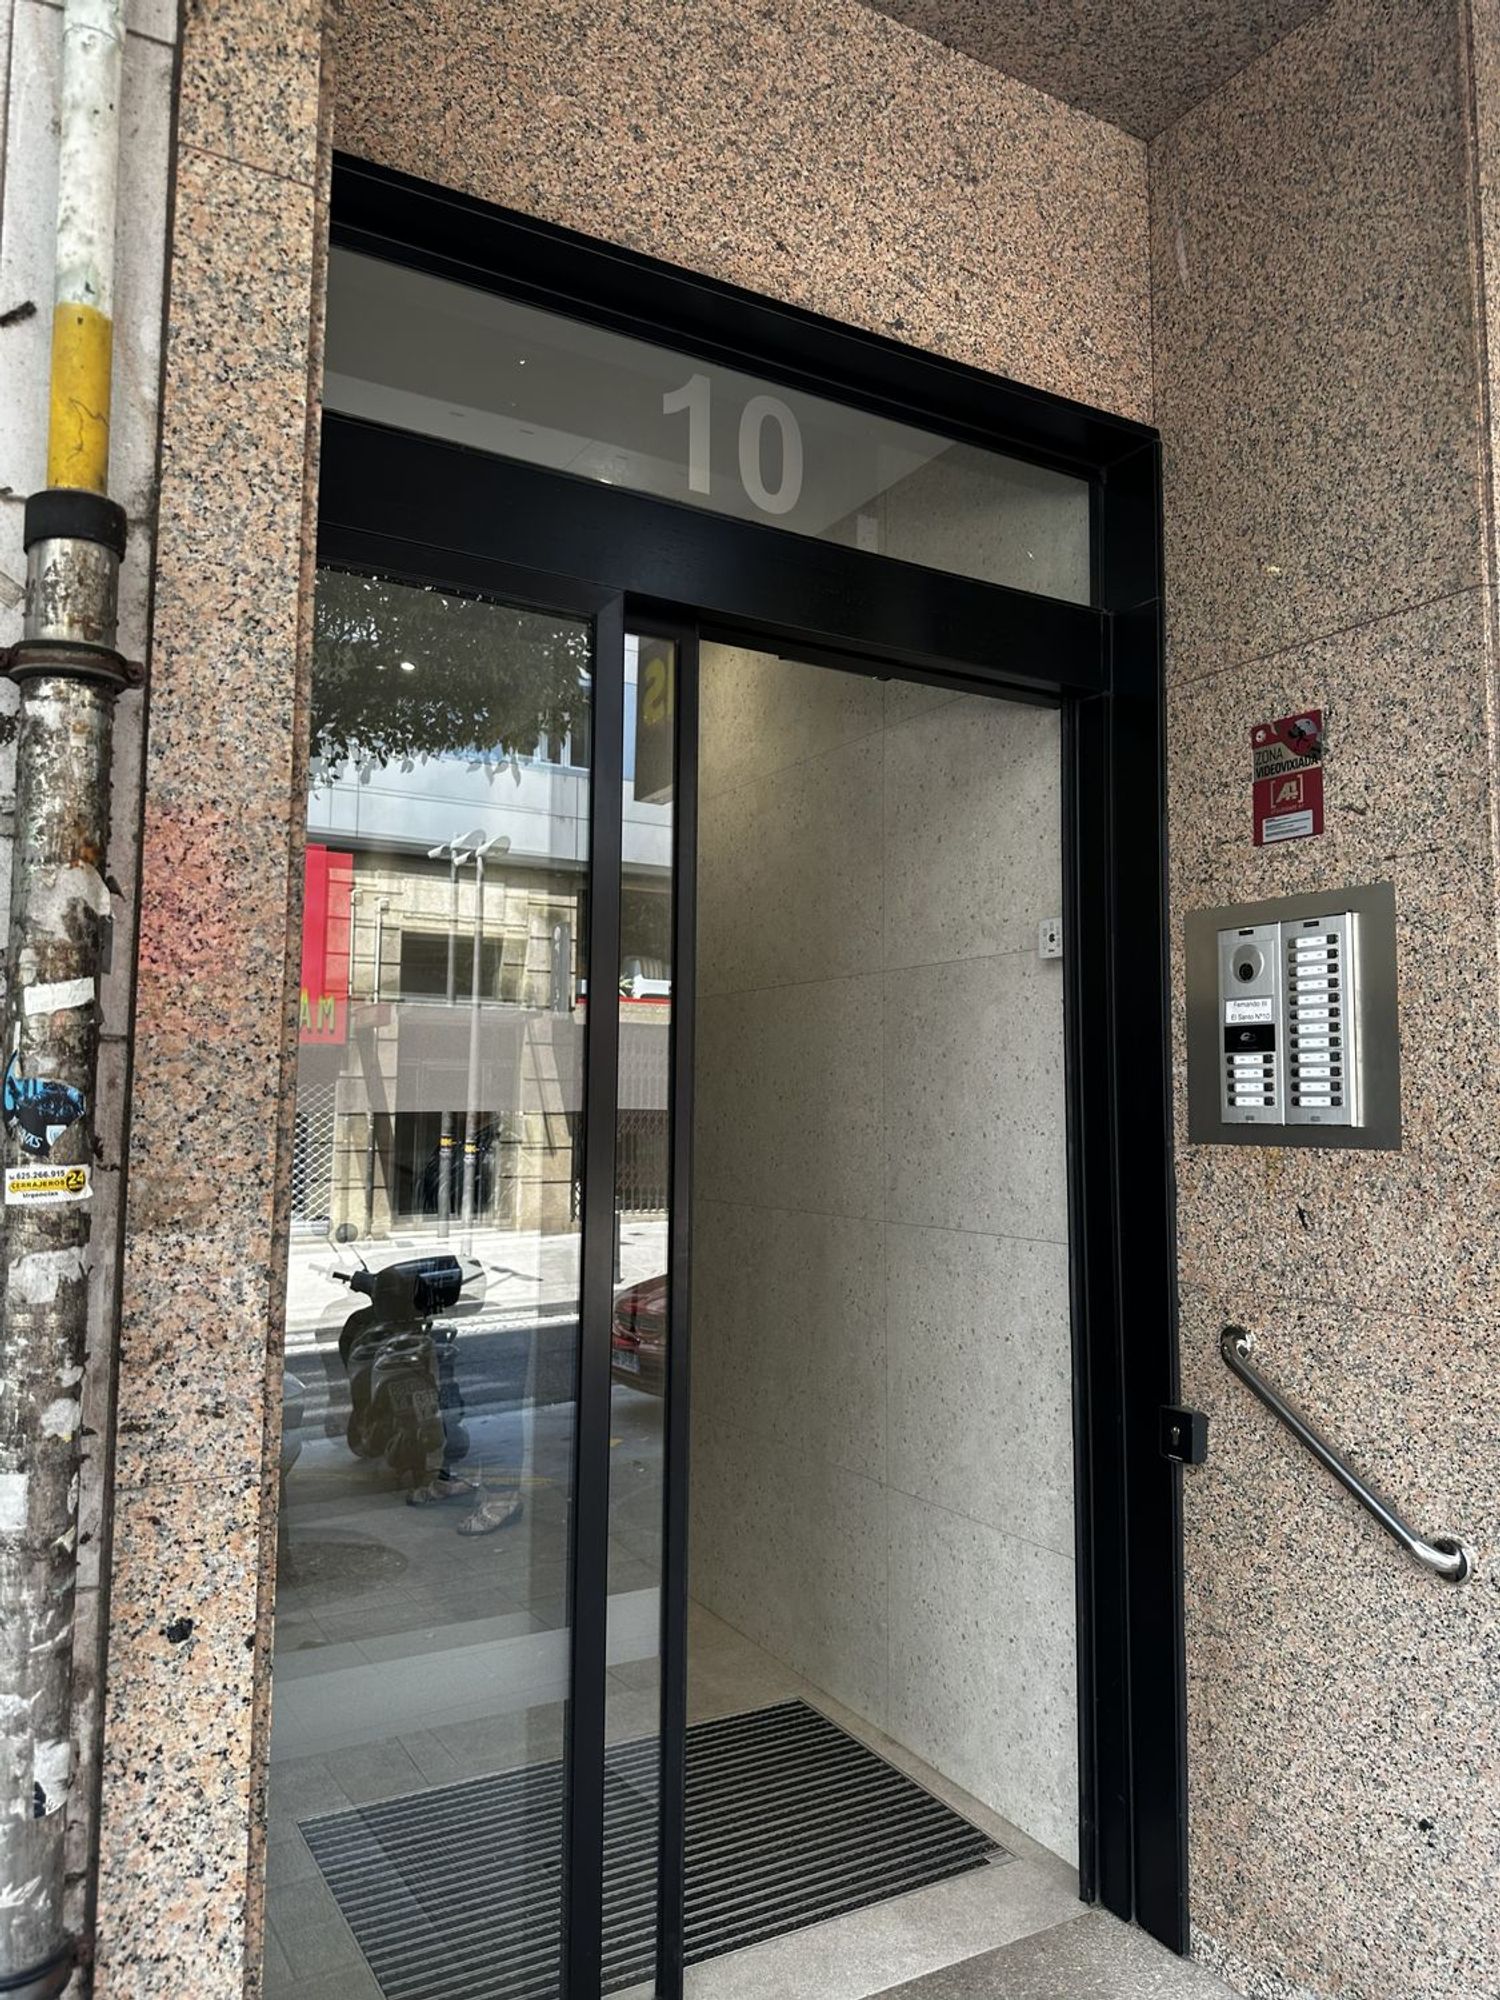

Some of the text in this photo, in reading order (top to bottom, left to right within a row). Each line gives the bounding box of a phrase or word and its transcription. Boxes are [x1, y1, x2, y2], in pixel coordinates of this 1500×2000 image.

[663, 373, 803, 515] 10
[1254, 747, 1284, 765] ZONA
[1255, 754, 1319, 778] VIDEOVIXIADA
[1238, 1013, 1254, 1021] Santo
[69, 1170, 84, 1184] 24
[11, 1180, 65, 1190] CERRAJEROS
[22, 1191, 59, 1199] Urgencias
